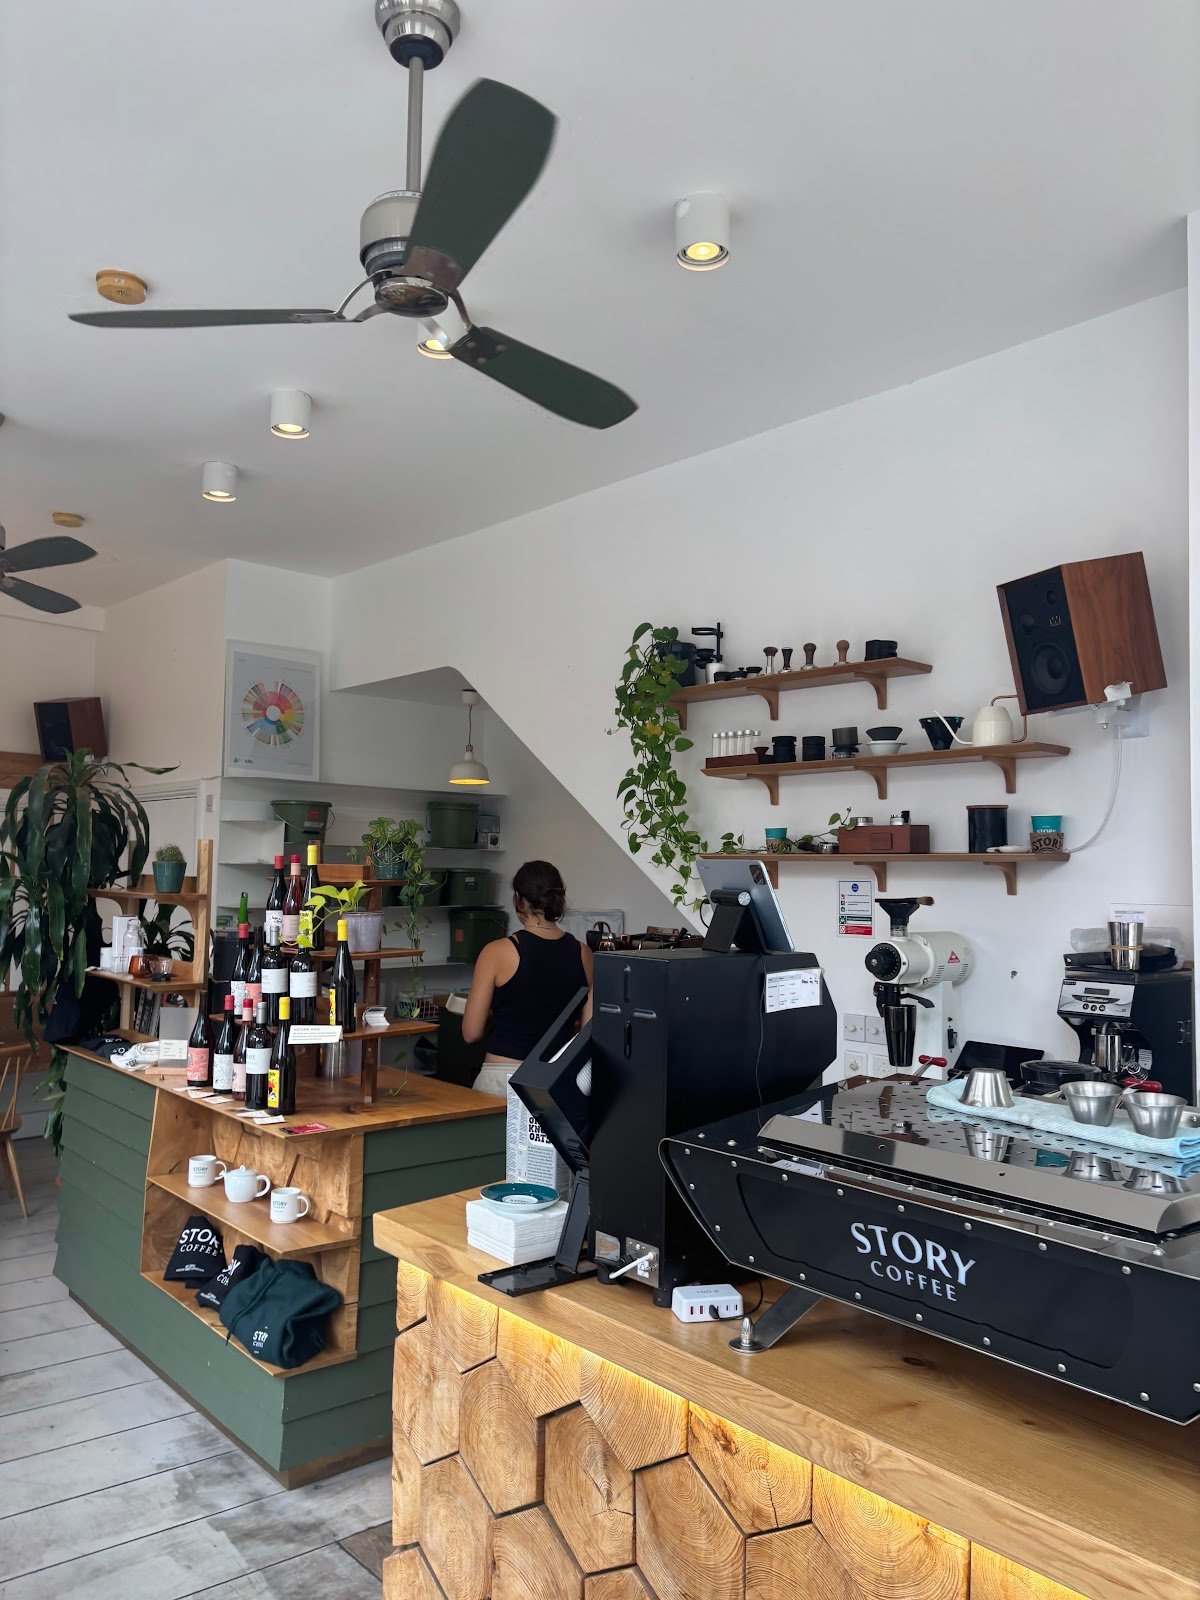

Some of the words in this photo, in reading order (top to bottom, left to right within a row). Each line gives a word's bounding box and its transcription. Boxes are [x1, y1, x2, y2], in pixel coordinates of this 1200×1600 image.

[180, 1244, 218, 1257] COFFEE
[850, 1222, 976, 1286] STORY
[870, 1260, 957, 1302] COFFEE
